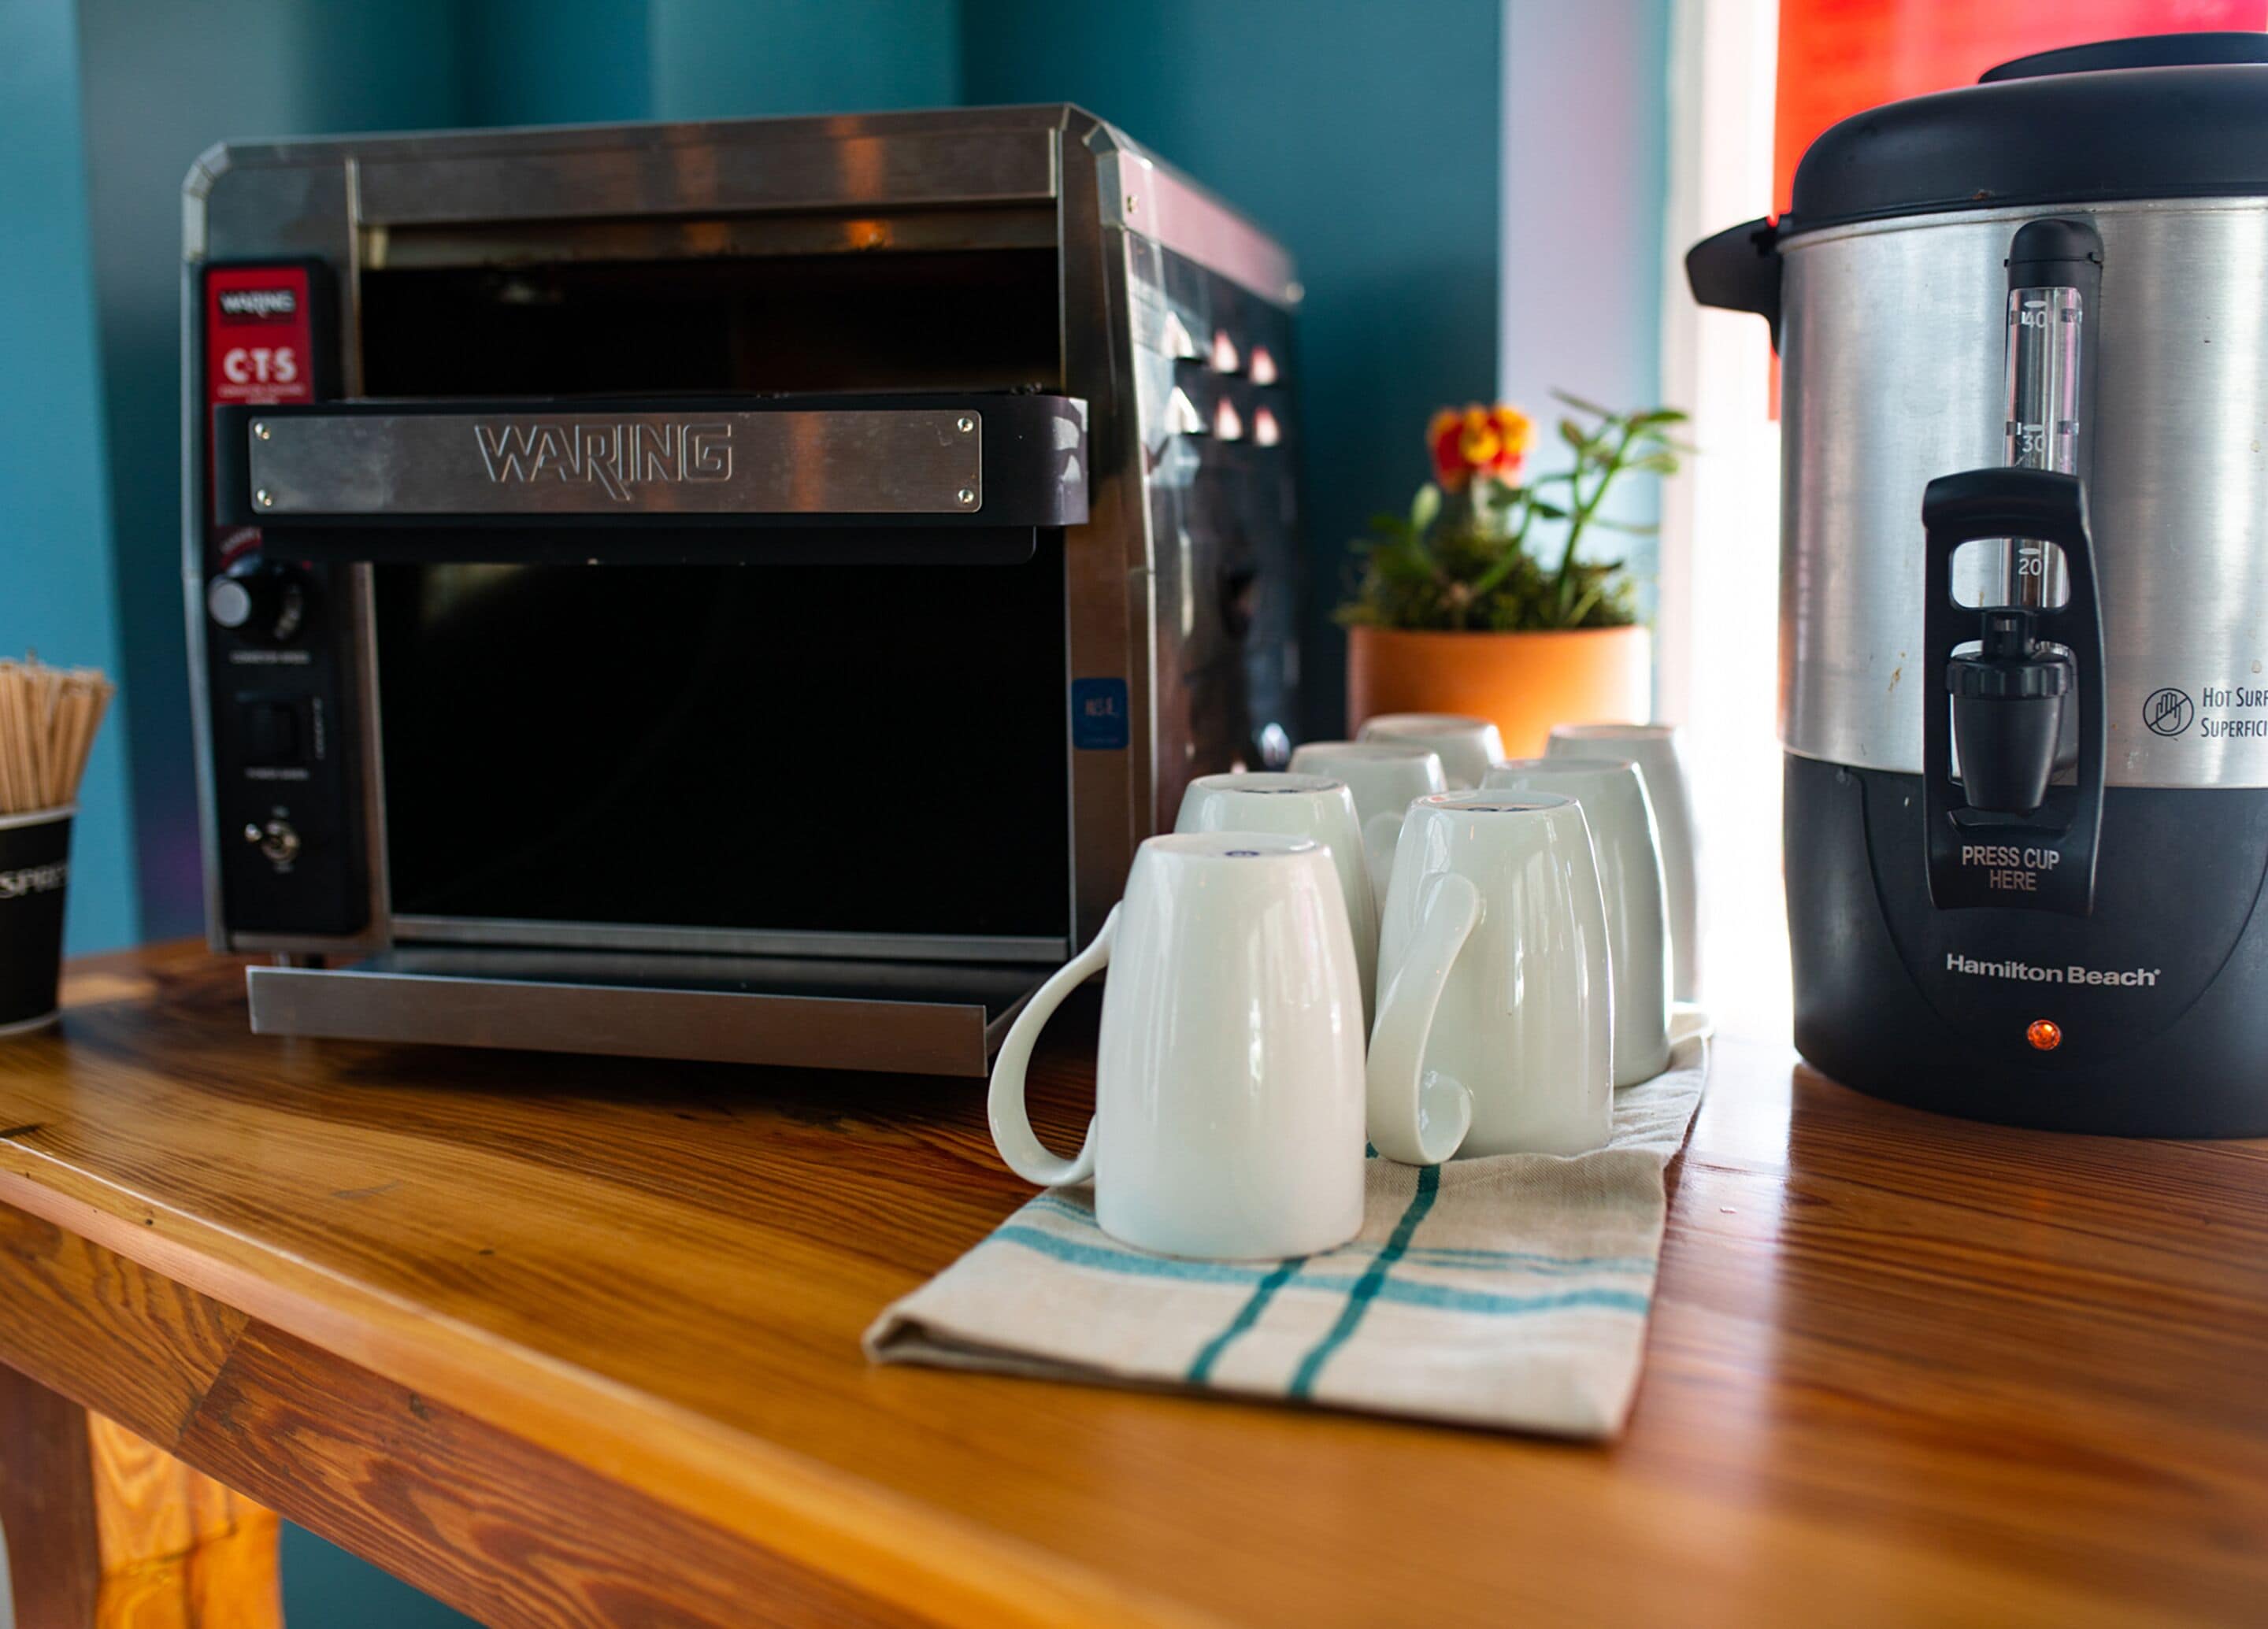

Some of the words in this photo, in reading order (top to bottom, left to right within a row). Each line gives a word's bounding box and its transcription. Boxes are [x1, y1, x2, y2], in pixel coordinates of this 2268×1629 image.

[223, 346, 298, 383] CTS
[2022, 435, 2046, 453] 30
[474, 424, 732, 501] WARING
[2018, 558, 2042, 576] 20
[1962, 846, 2020, 867] PRESS
[2024, 848, 2060, 870] CUP
[1990, 869, 2036, 890] HERE
[1946, 953, 2062, 983] Hamilton
[2067, 965, 2161, 987] Beach
